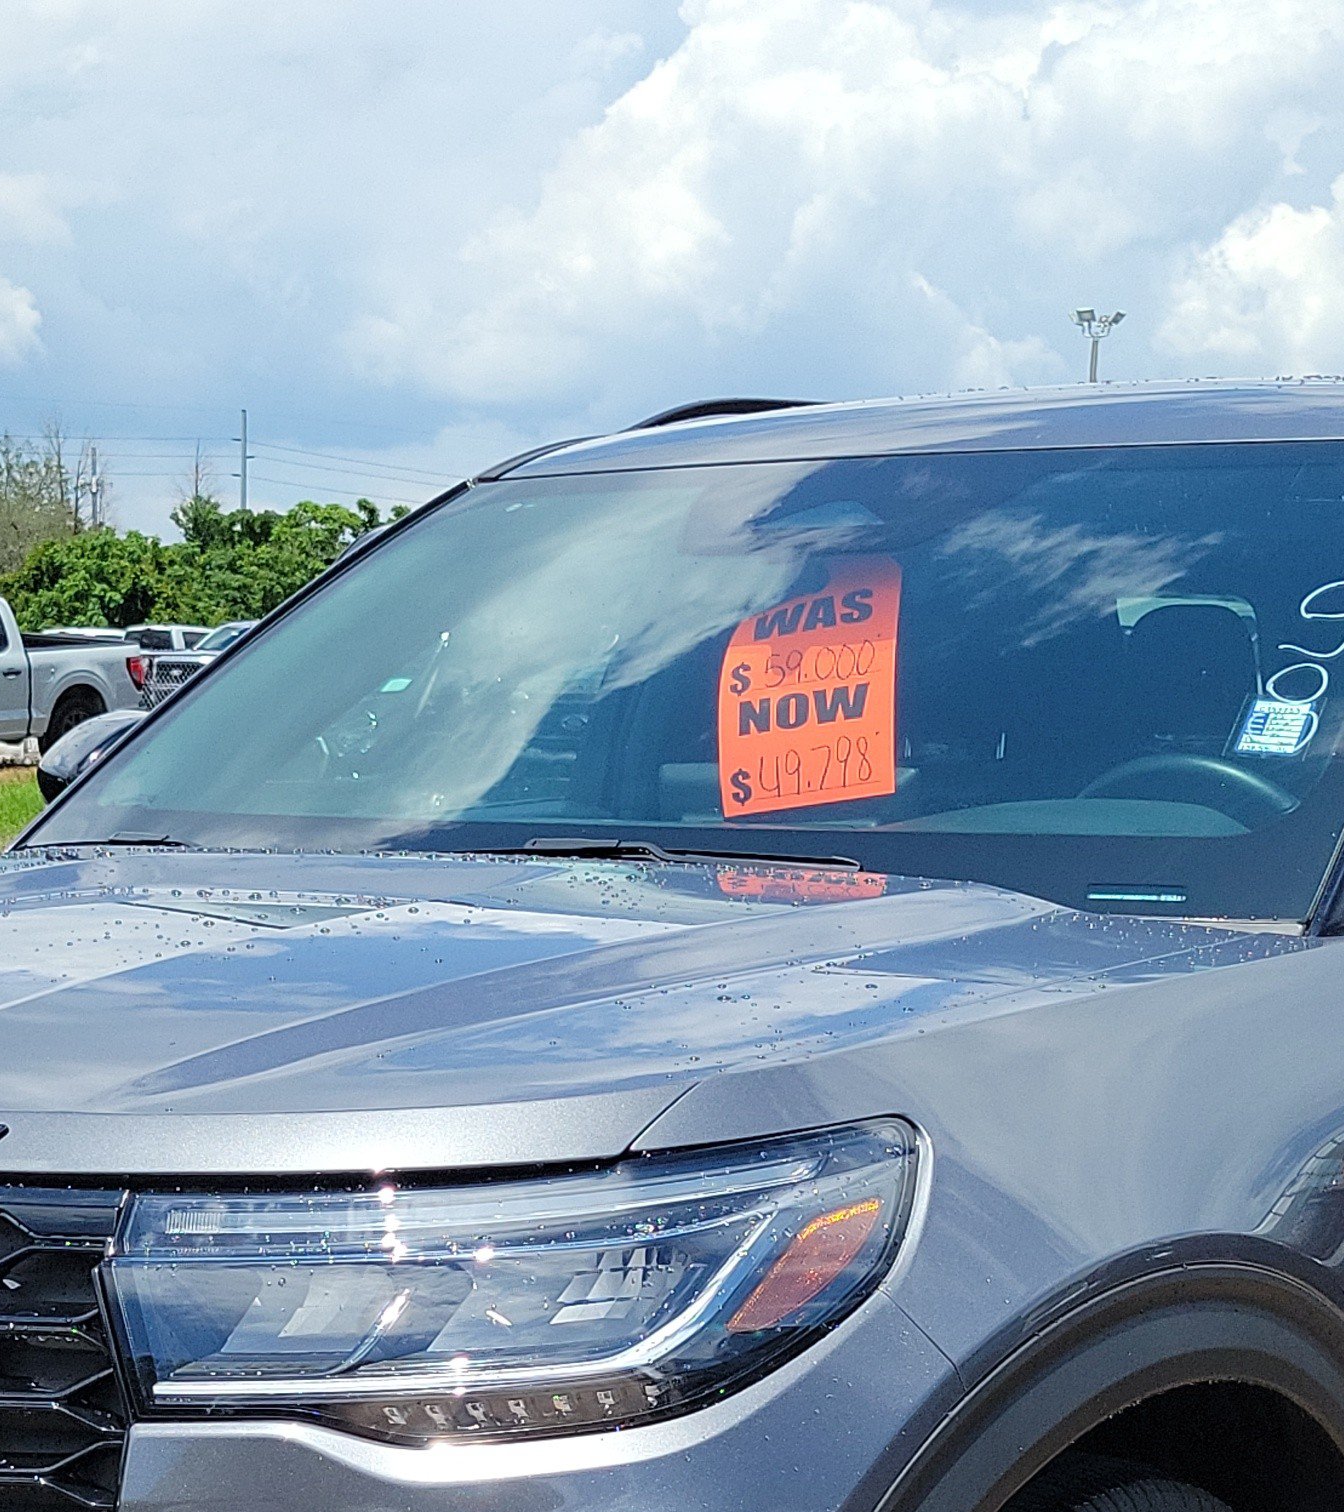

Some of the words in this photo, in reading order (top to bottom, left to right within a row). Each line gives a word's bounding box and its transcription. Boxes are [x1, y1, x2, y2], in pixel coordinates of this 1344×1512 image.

[754, 588, 873, 641] WAS
[729, 661, 752, 696] $
[738, 683, 870, 736] NOW
[729, 768, 752, 806] $
